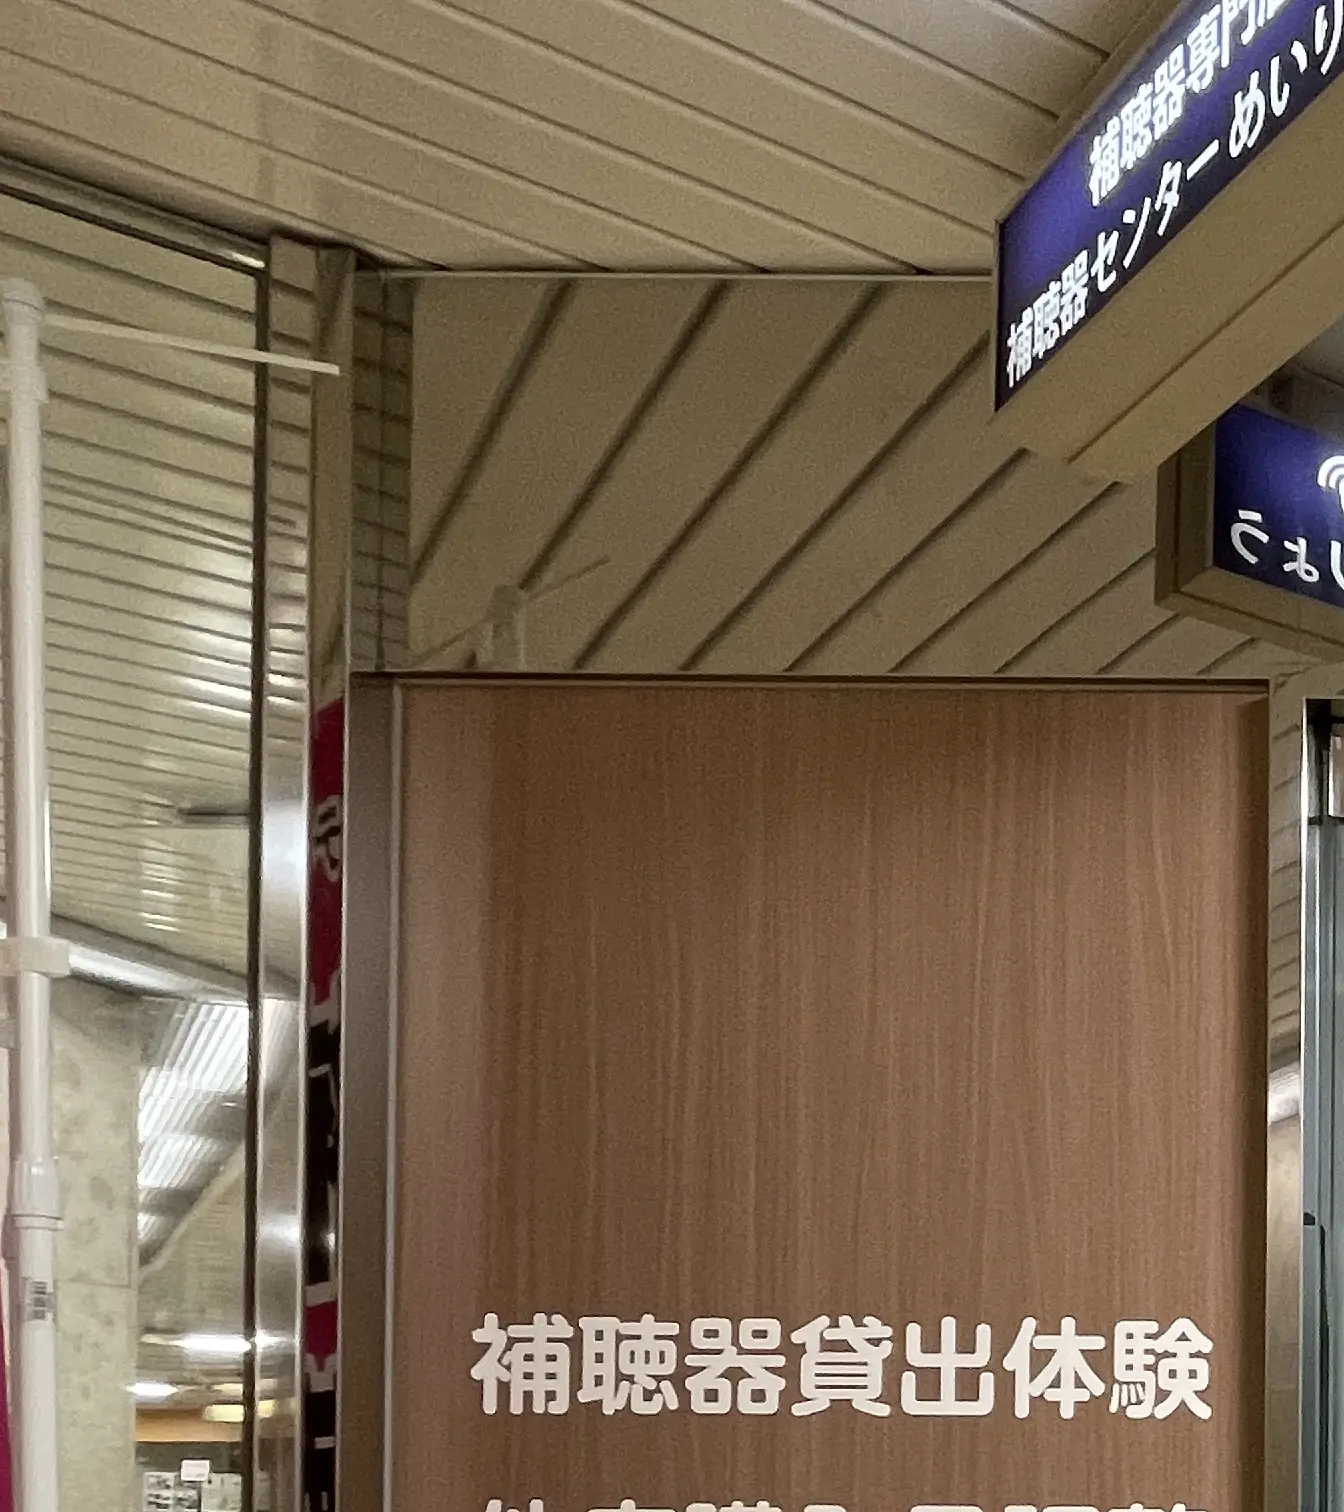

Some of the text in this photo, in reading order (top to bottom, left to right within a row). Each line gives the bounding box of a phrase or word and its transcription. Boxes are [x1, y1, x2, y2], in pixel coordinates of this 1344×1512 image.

[470, 1312, 1214, 1420] 補聴器貸出体験
